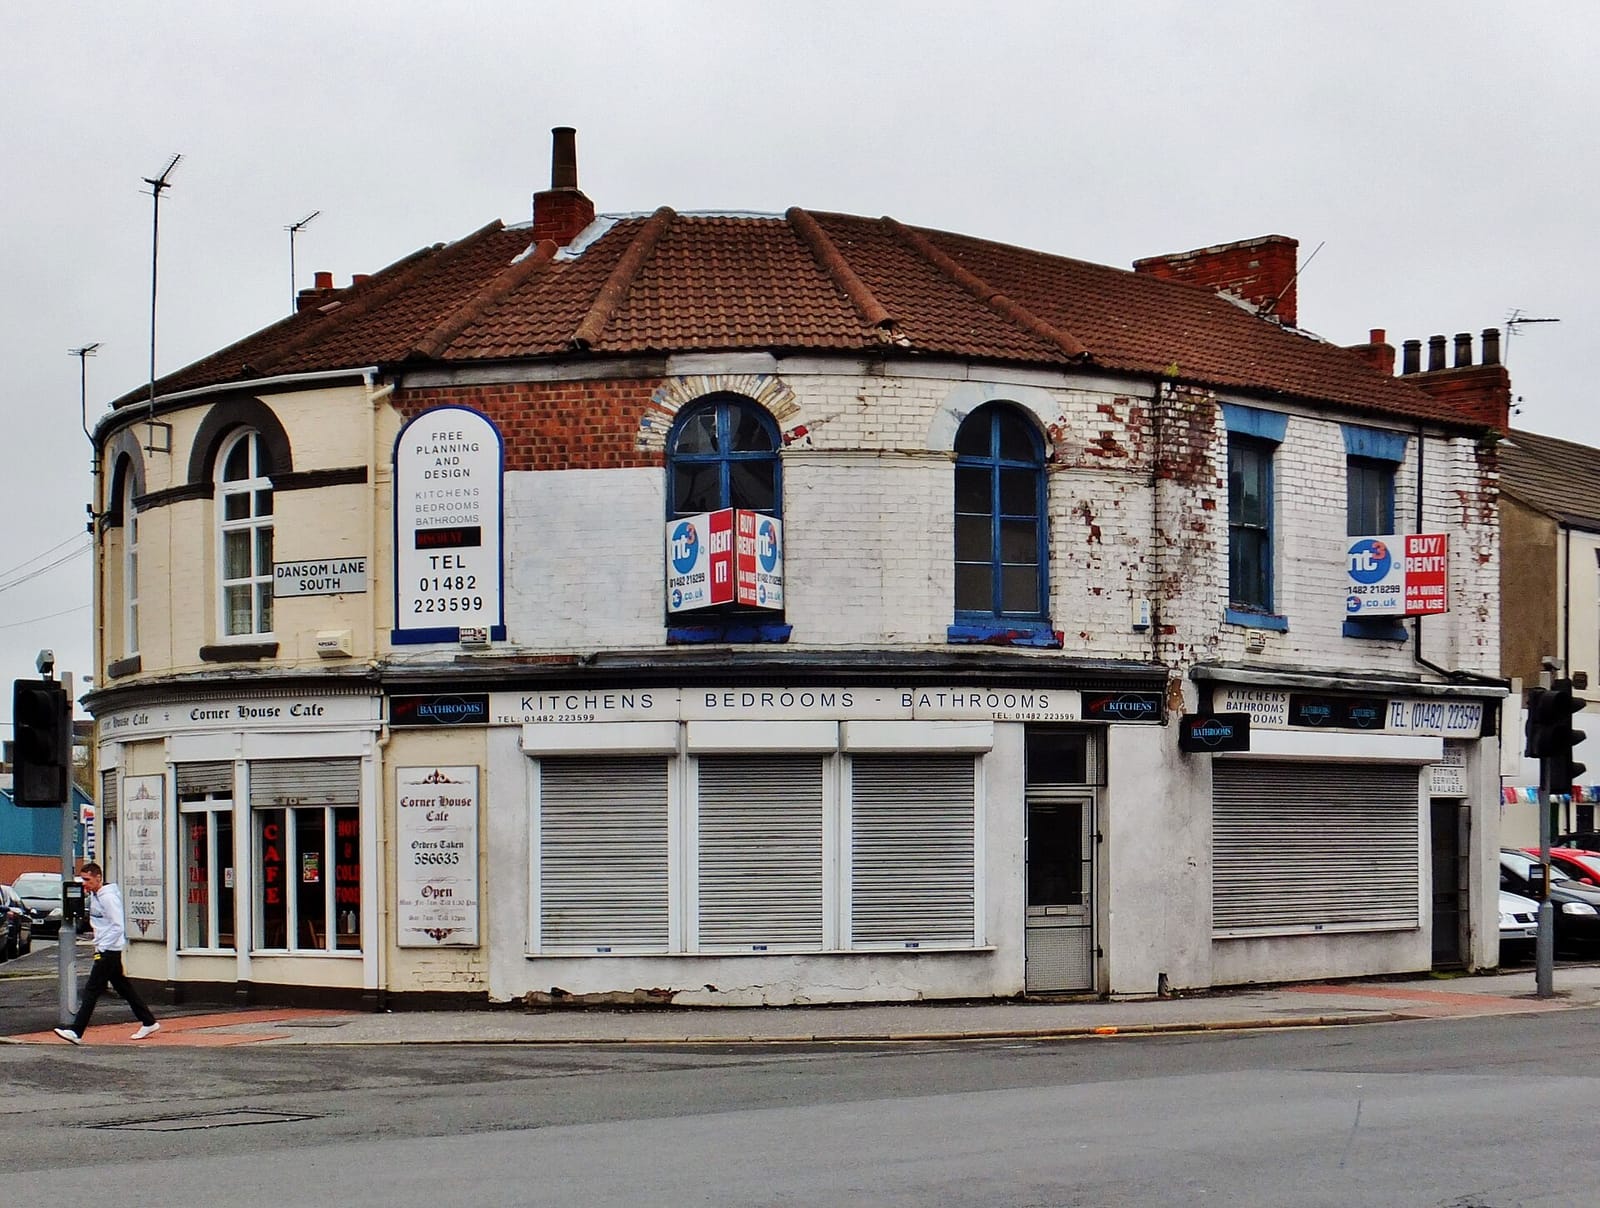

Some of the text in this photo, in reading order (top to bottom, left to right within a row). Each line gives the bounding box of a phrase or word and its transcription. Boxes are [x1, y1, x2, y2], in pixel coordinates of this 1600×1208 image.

[431, 431, 463, 441] FREE
[416, 442, 480, 455] PLANNING
[435, 456, 460, 466] AND
[424, 468, 471, 480] DESIGN
[415, 487, 480, 500] KITCHENS
[415, 501, 480, 513] BEDROOMS
[415, 514, 480, 526] BATHROOMS
[429, 554, 466, 570] TEL
[1406, 556, 1445, 573] RENT!
[277, 562, 365, 578] DANSOM LANE
[299, 578, 341, 591] SOUTH
[420, 575, 476, 592] 01482
[1420, 585, 1444, 595] WINE
[414, 596, 483, 613] 223599
[1406, 599, 1444, 609] BAR USE
[1227, 688, 1286, 702] KITCHENS
[521, 692, 1050, 711] KITCHENS BEDROOMS BATHROOMS
[1109, 701, 1152, 711] KITCHENS
[1226, 701, 1284, 713] BATHROOMS
[190, 703, 325, 721] Corner House Cafe
[419, 703, 481, 714] BATHROOMS
[525, 715, 554, 723] 01482
[558, 713, 595, 722] 223599
[1015, 712, 1041, 720] 01482
[1044, 712, 1075, 720] 223599
[1411, 702, 1445, 731] (01482)
[1447, 703, 1481, 730] 223599
[1193, 727, 1232, 737] BATHROOMS
[1429, 784, 1464, 793] AVAILABLE
[400, 795, 472, 808] Corner House
[425, 810, 449, 822] Cafe
[411, 840, 464, 849] Orders Taken
[263, 823, 280, 904] CAFE
[414, 852, 459, 865] 586635
[421, 885, 453, 899] Open
